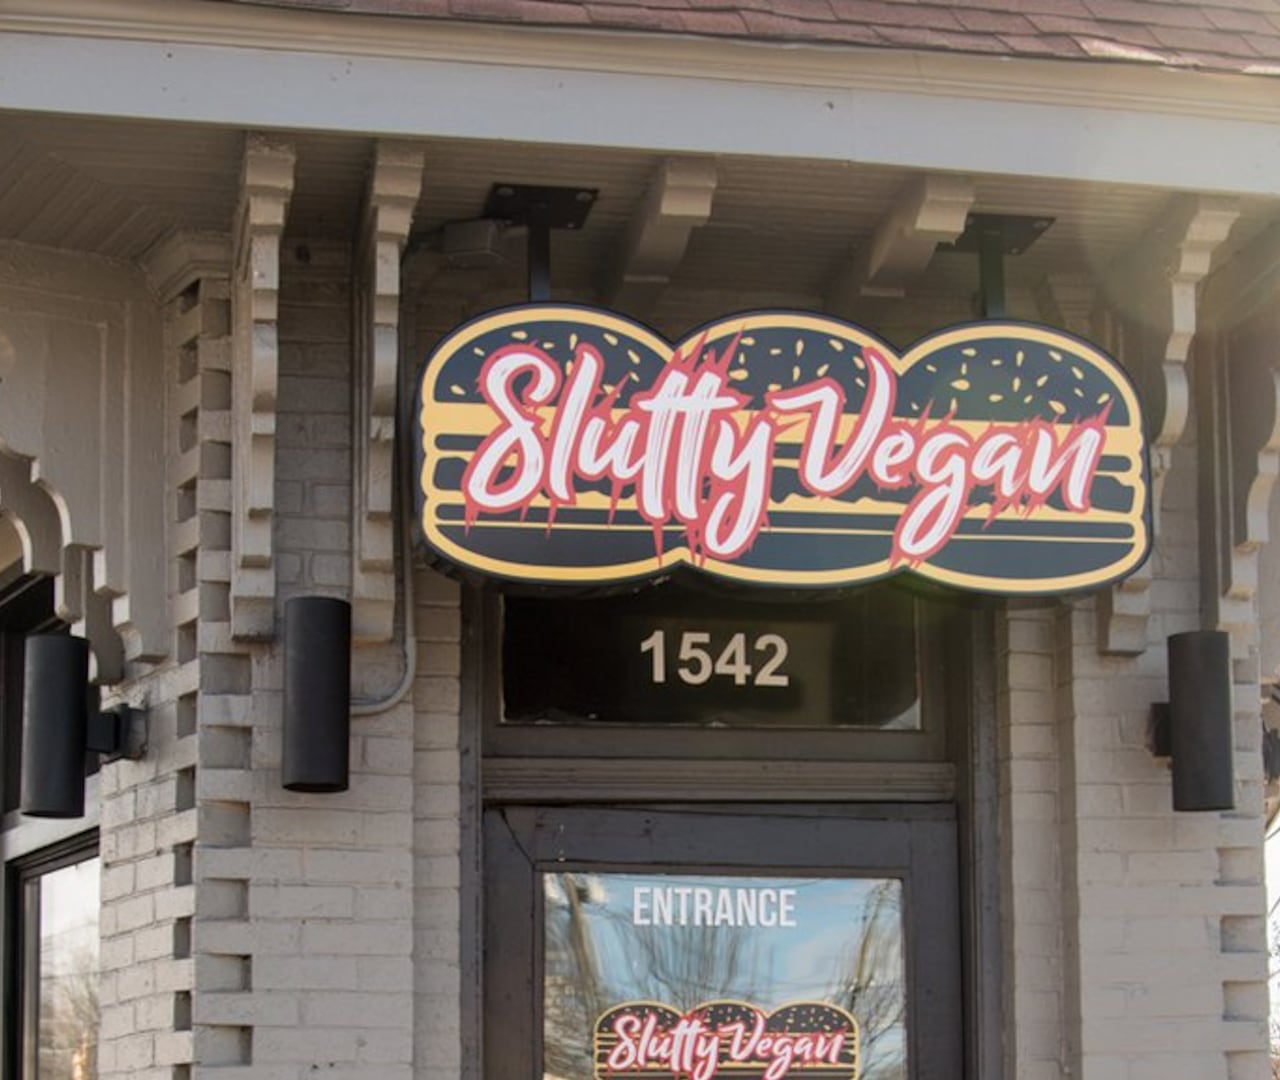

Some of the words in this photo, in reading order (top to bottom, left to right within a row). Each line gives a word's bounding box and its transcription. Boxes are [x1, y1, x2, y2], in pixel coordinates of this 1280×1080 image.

[463, 345, 776, 558] Slutty
[771, 346, 1104, 558] Vegan
[640, 629, 790, 688] 1542
[633, 886, 798, 928] ENTRANCE
